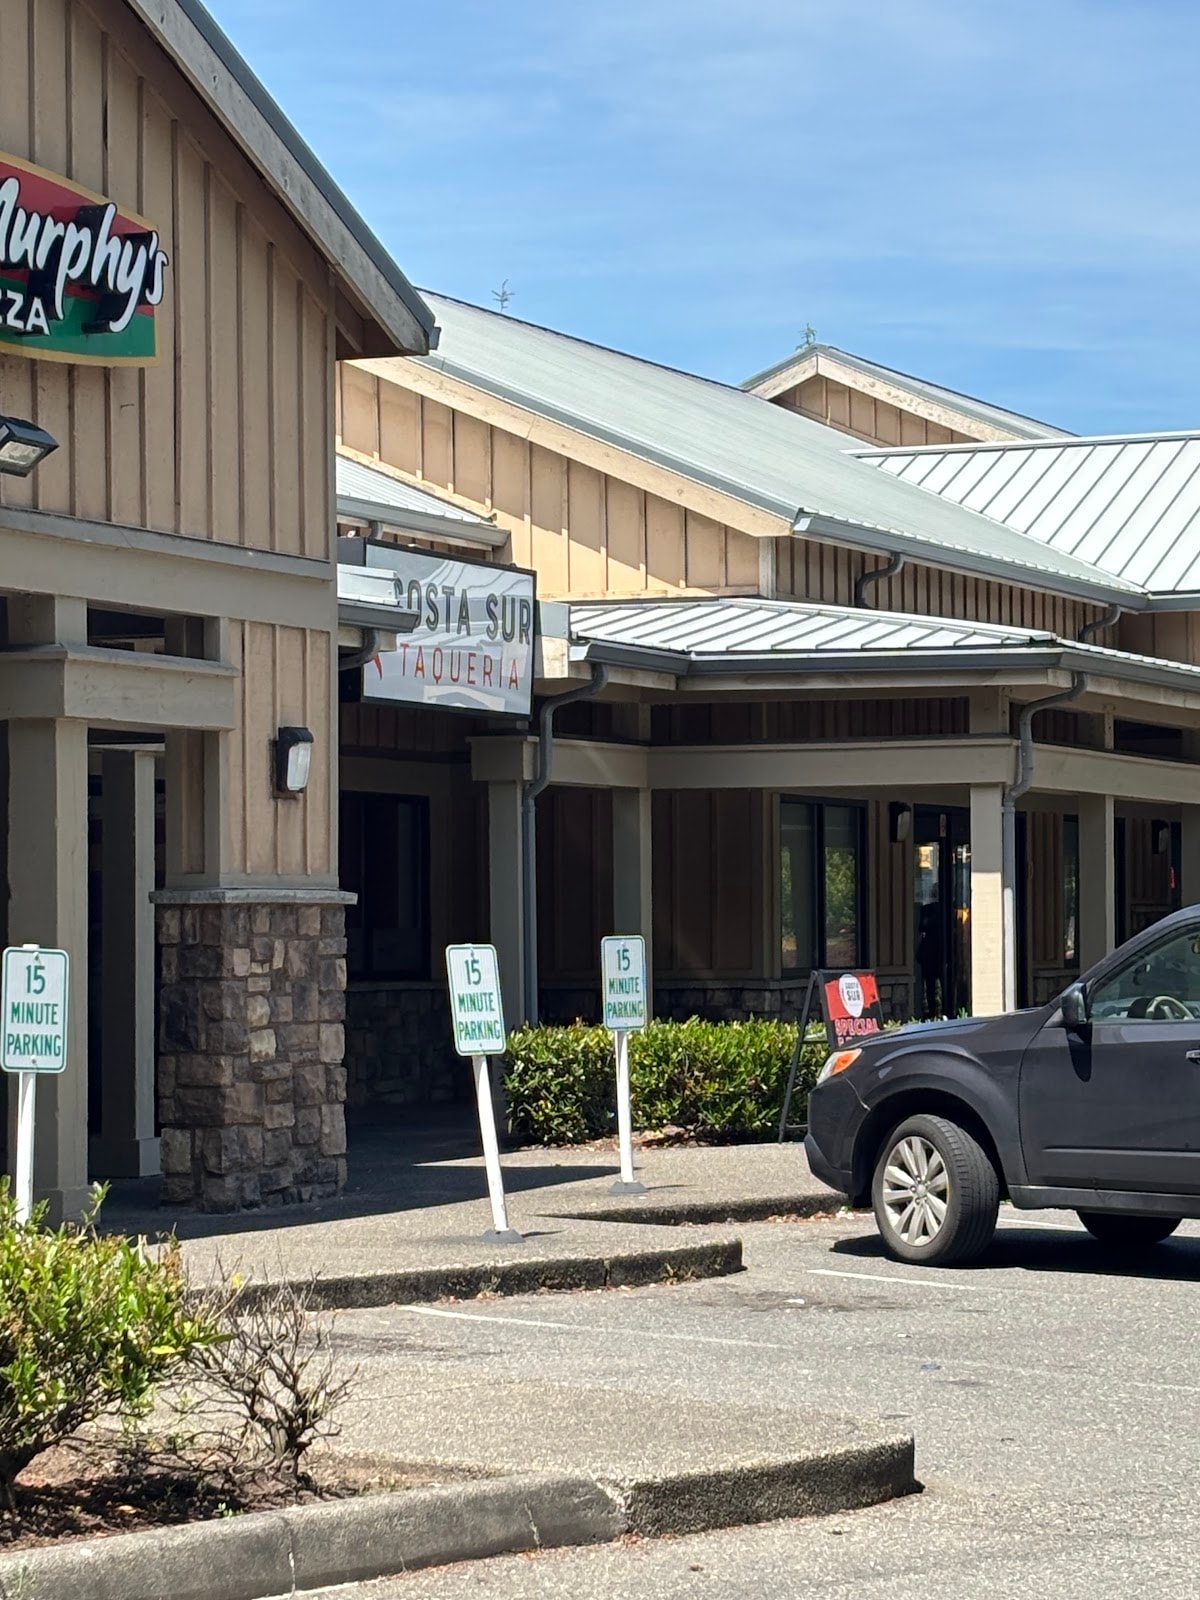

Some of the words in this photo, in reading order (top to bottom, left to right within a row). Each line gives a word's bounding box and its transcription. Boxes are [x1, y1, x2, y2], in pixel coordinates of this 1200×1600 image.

[0, 288, 50, 336] ZA
[486, 593, 530, 645] SUR
[400, 642, 519, 691] TAQUERIA
[464, 959, 481, 985] 15
[616, 949, 630, 971] 15
[26, 964, 46, 994] 15
[608, 976, 640, 994] MINUTE
[11, 1001, 59, 1025] MINUTE
[457, 992, 495, 1012] MINUTE
[607, 1000, 643, 1018] PARKING
[458, 1020, 500, 1040] PARKING
[7, 1033, 62, 1057] PARKING
